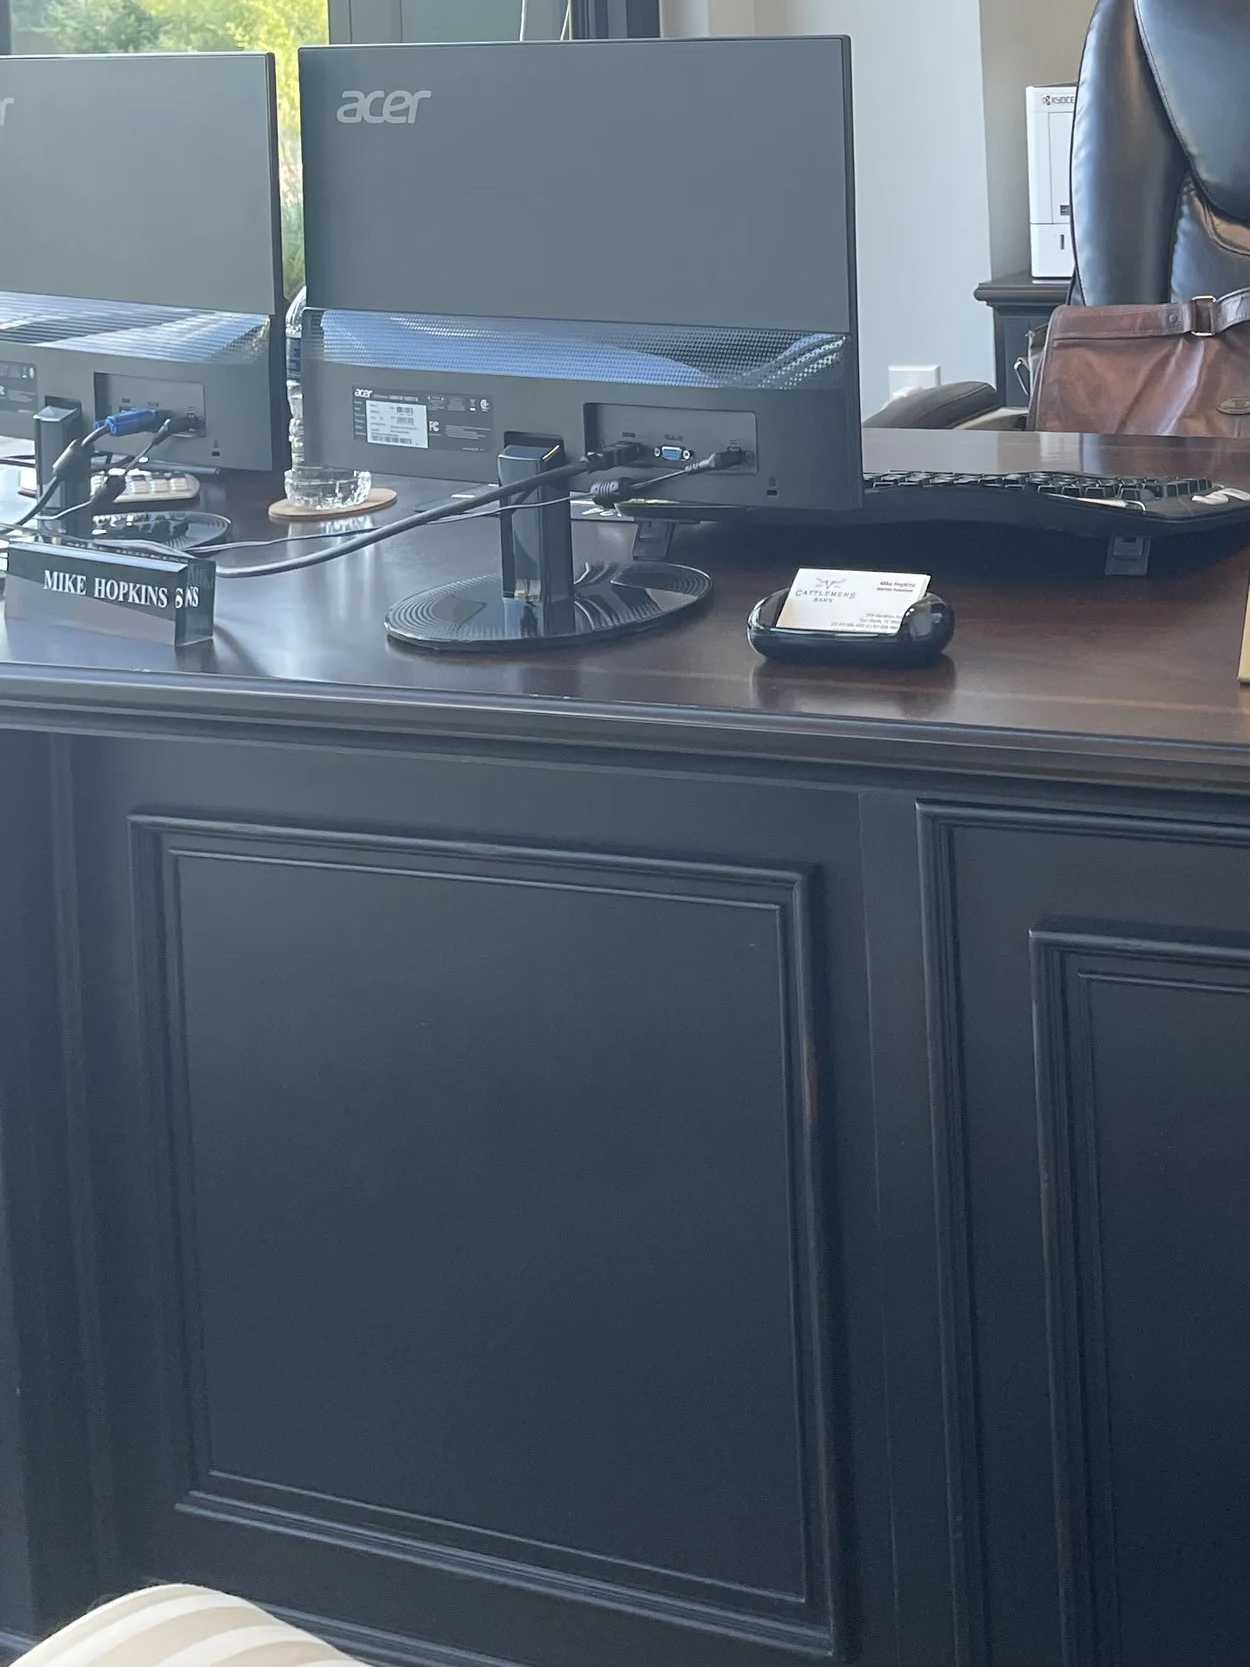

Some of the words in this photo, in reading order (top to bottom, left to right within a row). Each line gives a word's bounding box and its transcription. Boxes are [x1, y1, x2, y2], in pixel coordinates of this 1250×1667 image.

[336, 89, 432, 124] acer
[354, 388, 374, 399] acer
[43, 569, 87, 596] MIKE
[93, 577, 168, 609] HOPKINS
